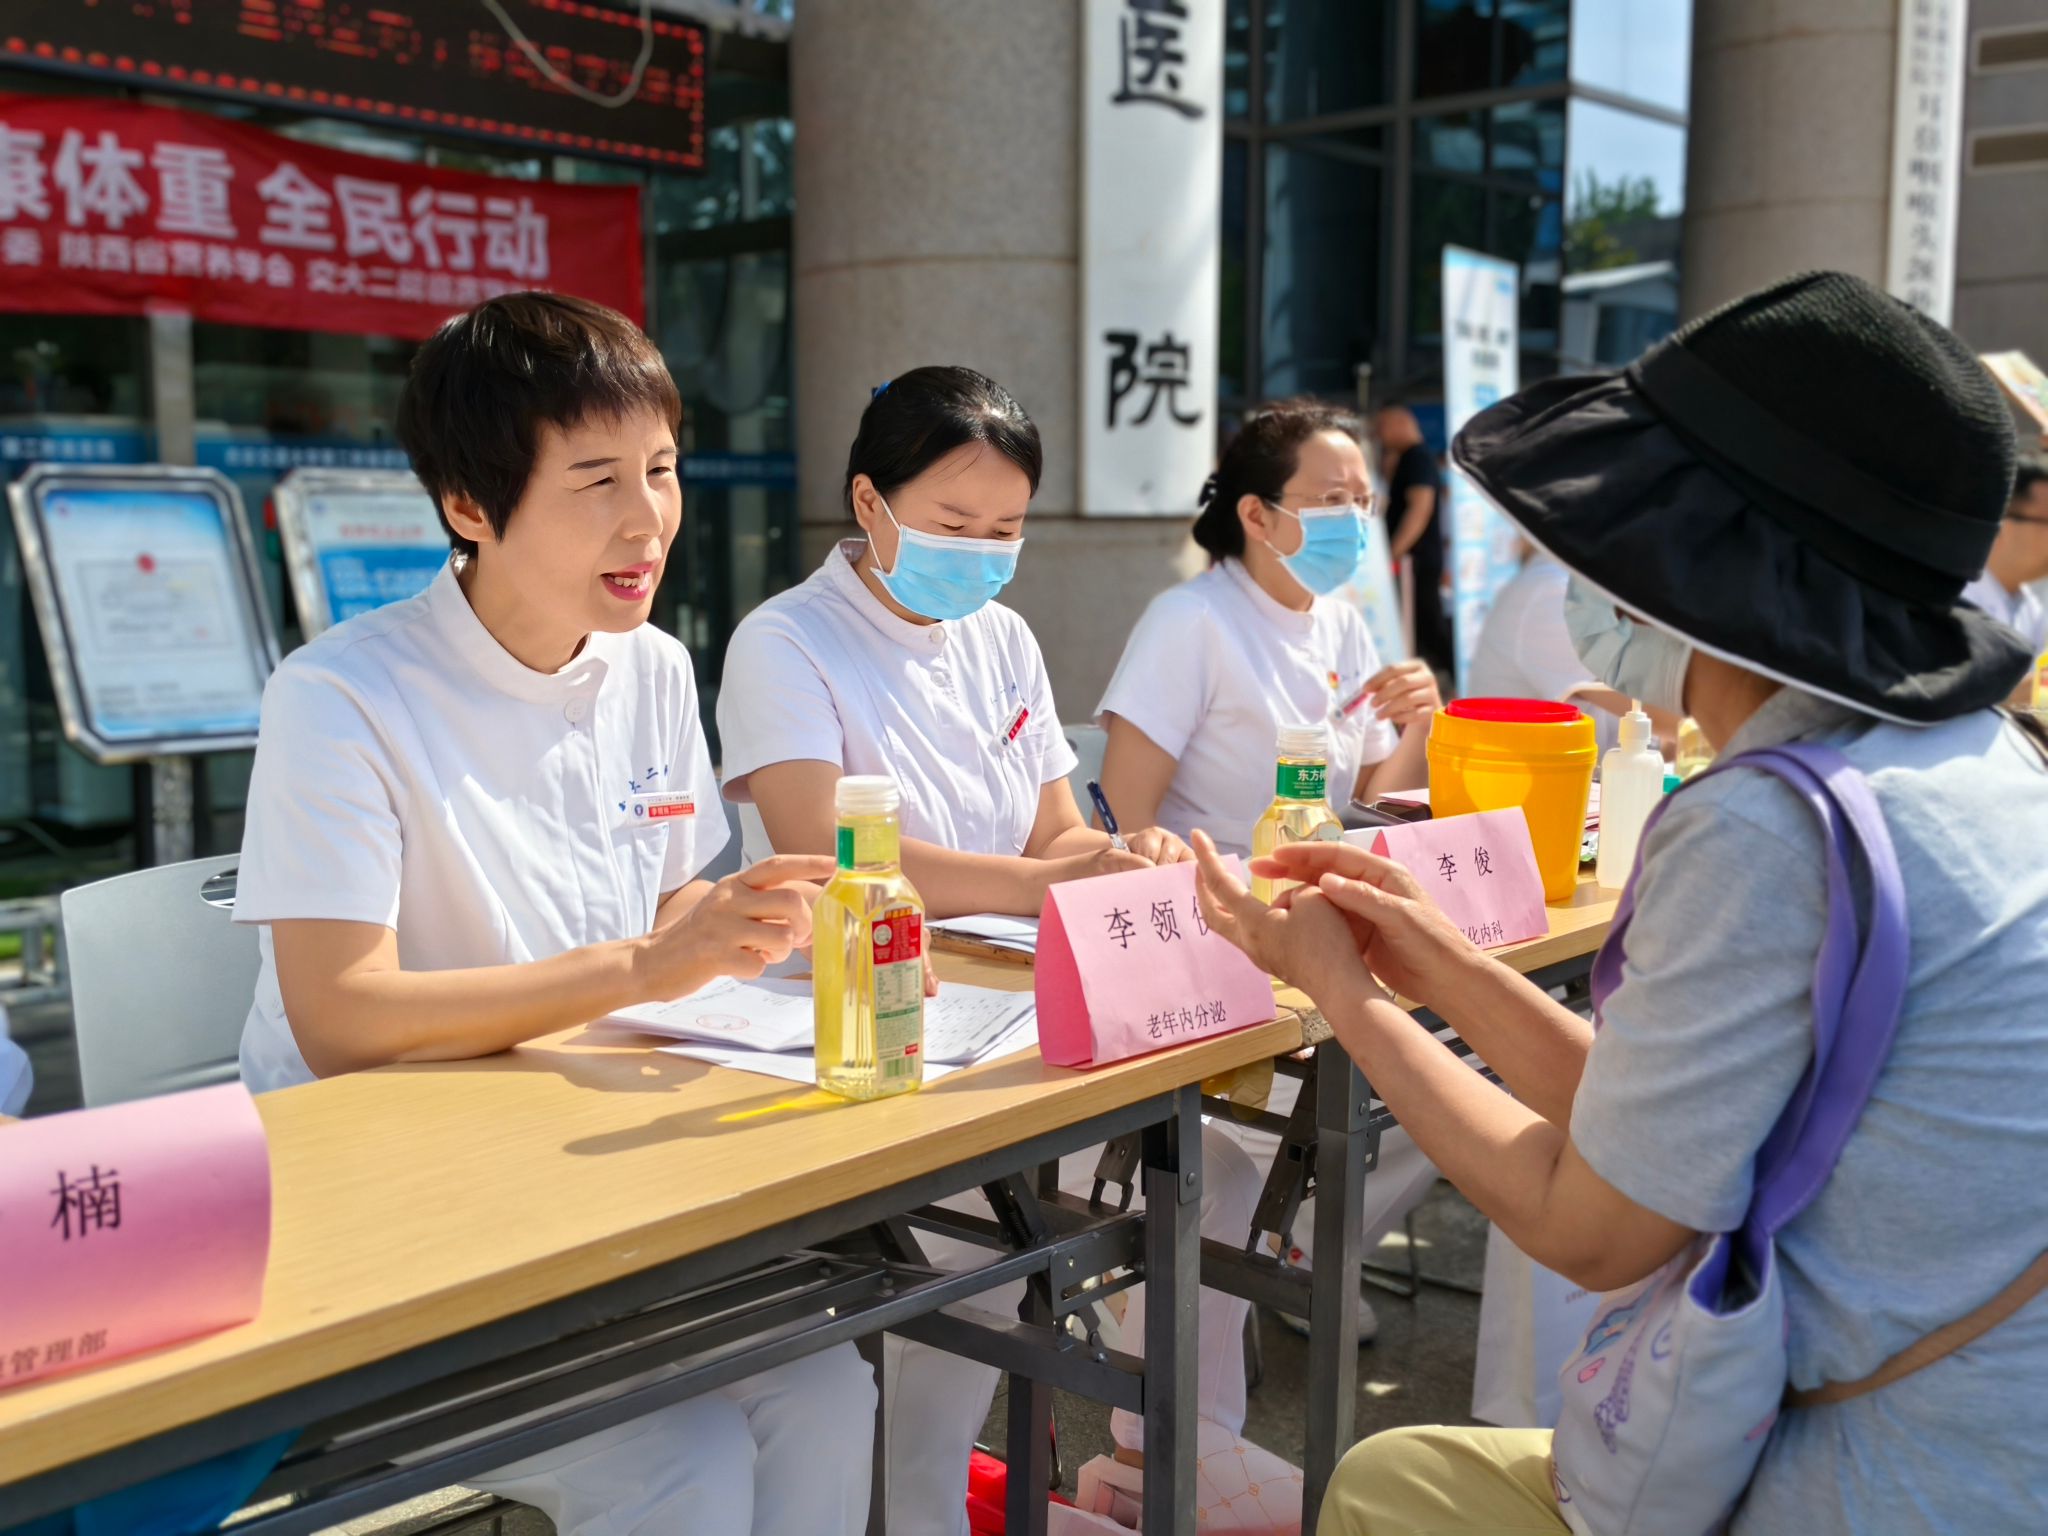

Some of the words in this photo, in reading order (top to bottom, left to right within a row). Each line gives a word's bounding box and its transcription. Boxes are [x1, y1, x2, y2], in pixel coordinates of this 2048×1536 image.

[256, 160, 548, 280] 全民行动
[1104, 0, 1205, 429] 医院
[1437, 846, 1493, 882] 李俊
[1146, 1000, 1227, 1039] 老年内分泌
[50, 1164, 122, 1242] 楠
[0, 1329, 108, 1375] 管理部
